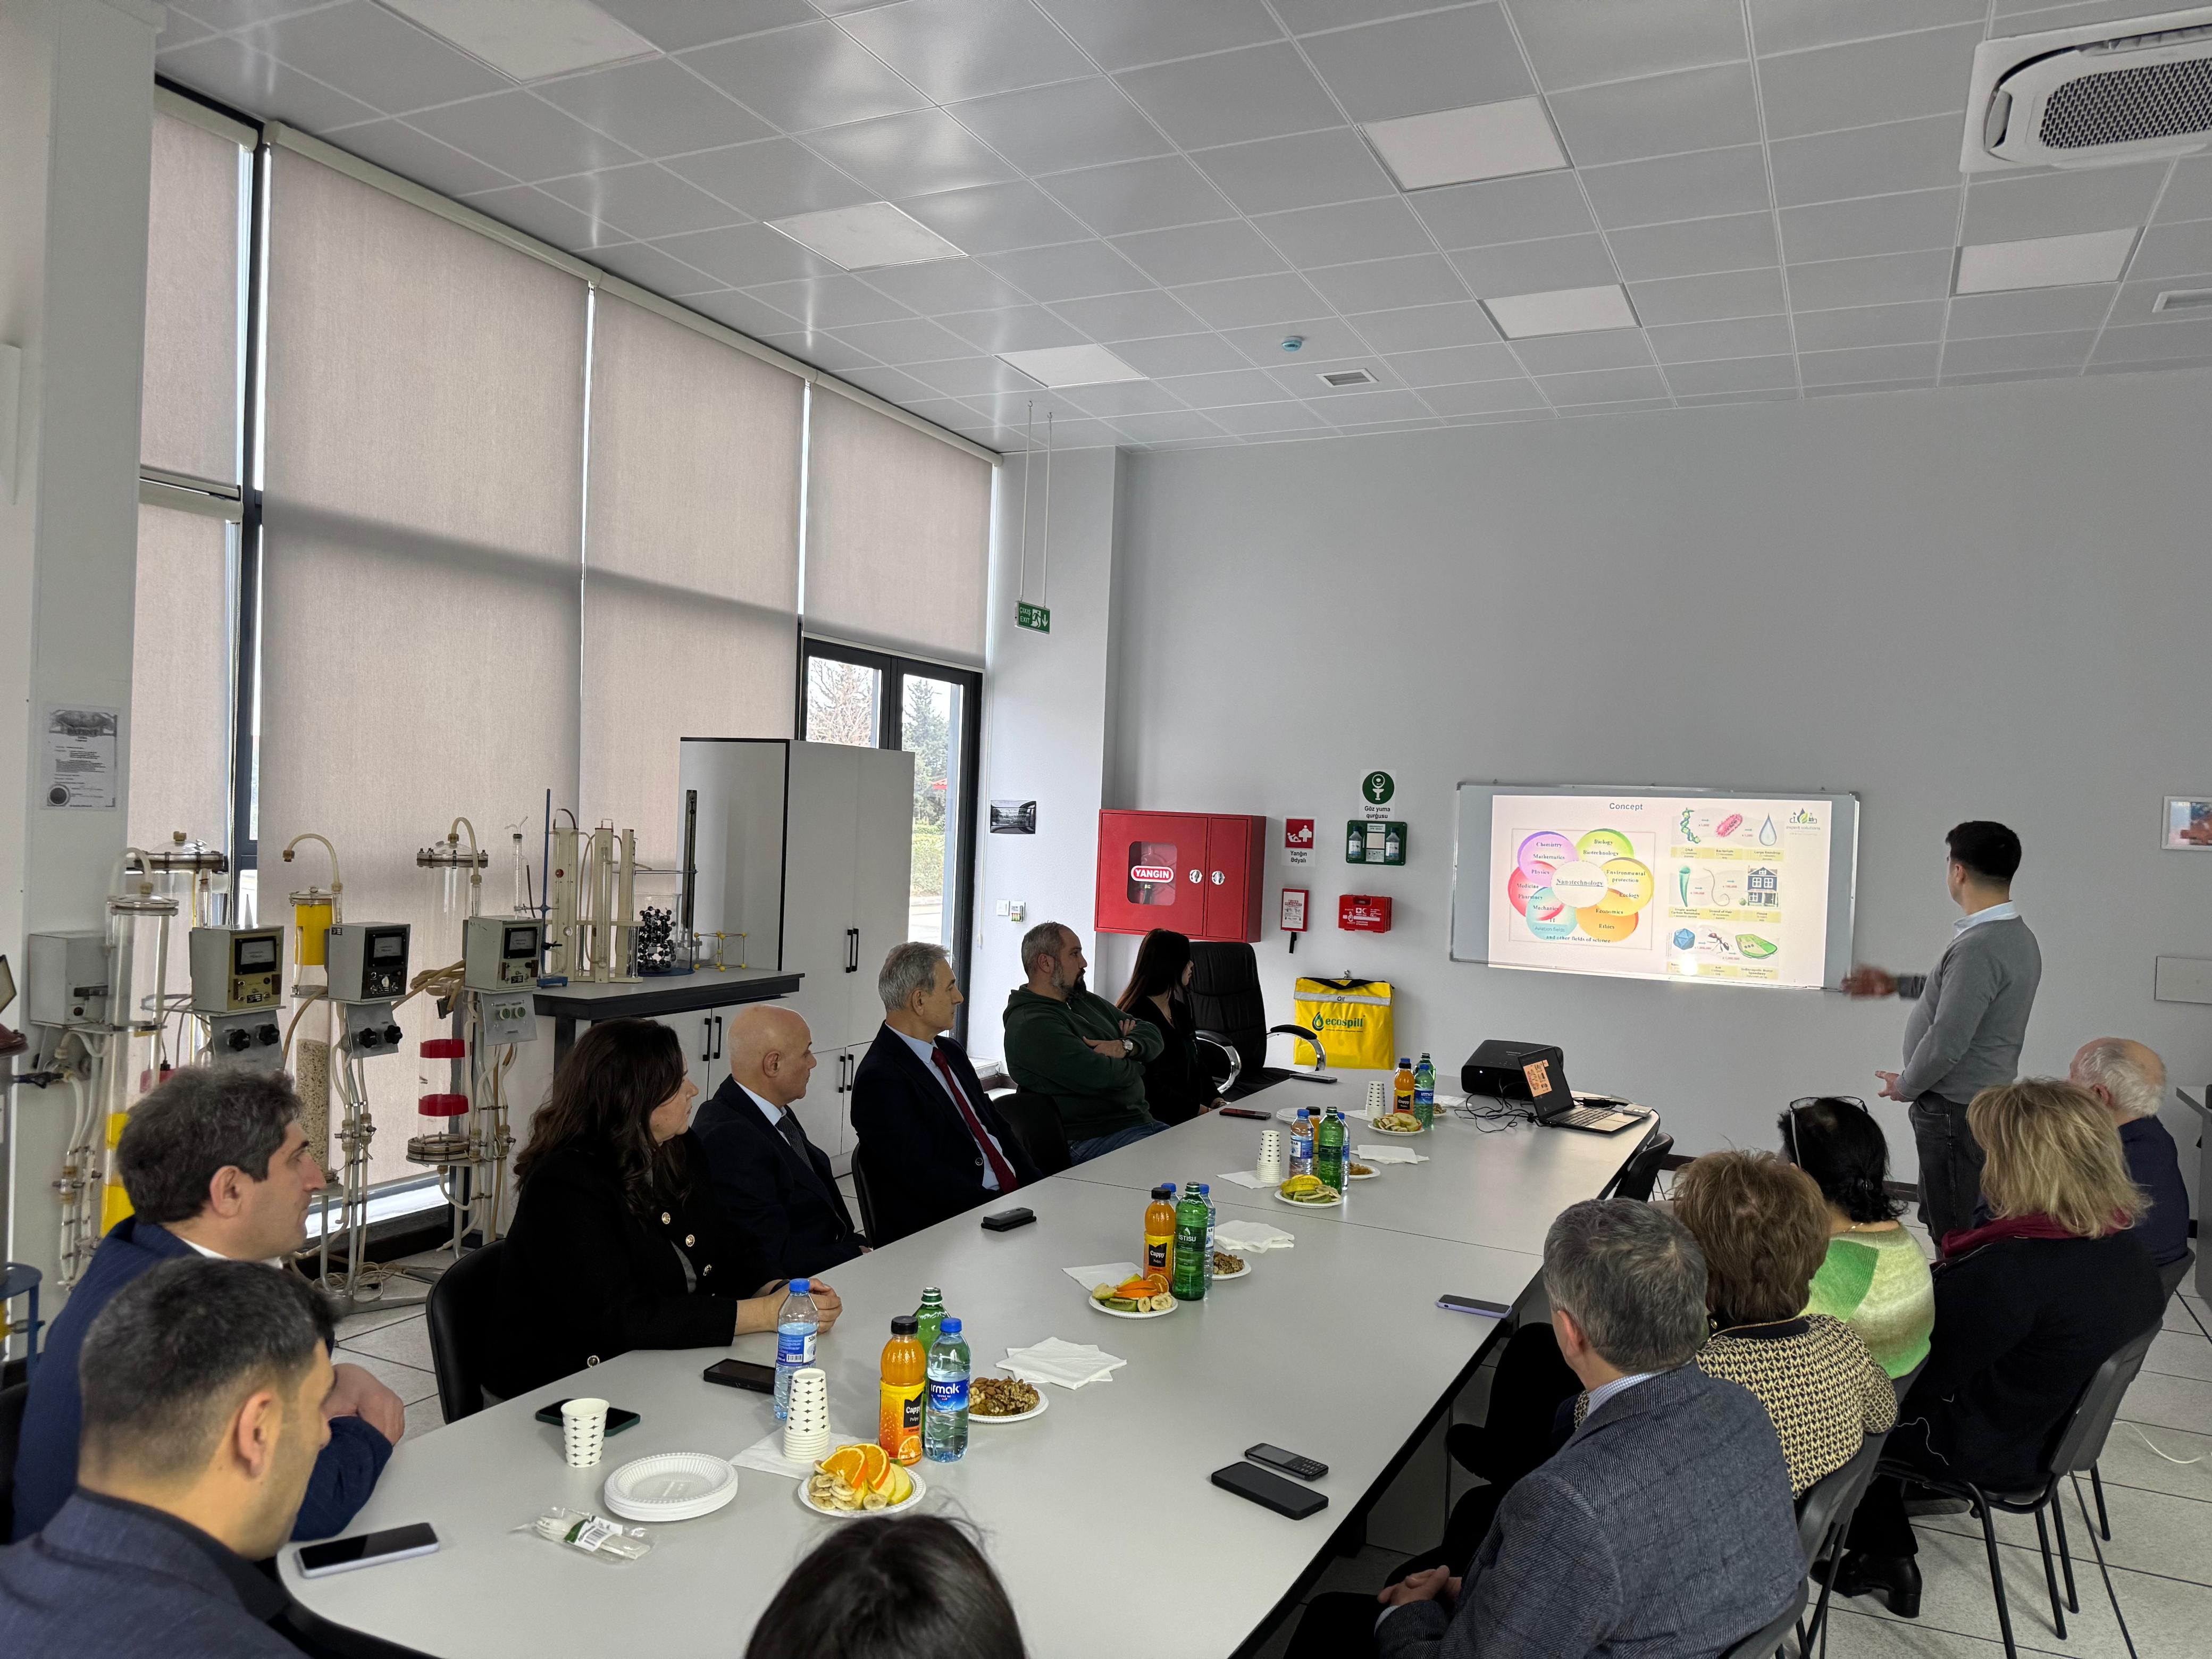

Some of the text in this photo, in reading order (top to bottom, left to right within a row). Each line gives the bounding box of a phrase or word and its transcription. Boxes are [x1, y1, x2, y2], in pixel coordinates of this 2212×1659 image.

[1609, 802, 1643, 811] Concept
[1135, 869, 1169, 878] YANGIN
[1326, 1018, 1363, 1028] ecospill
